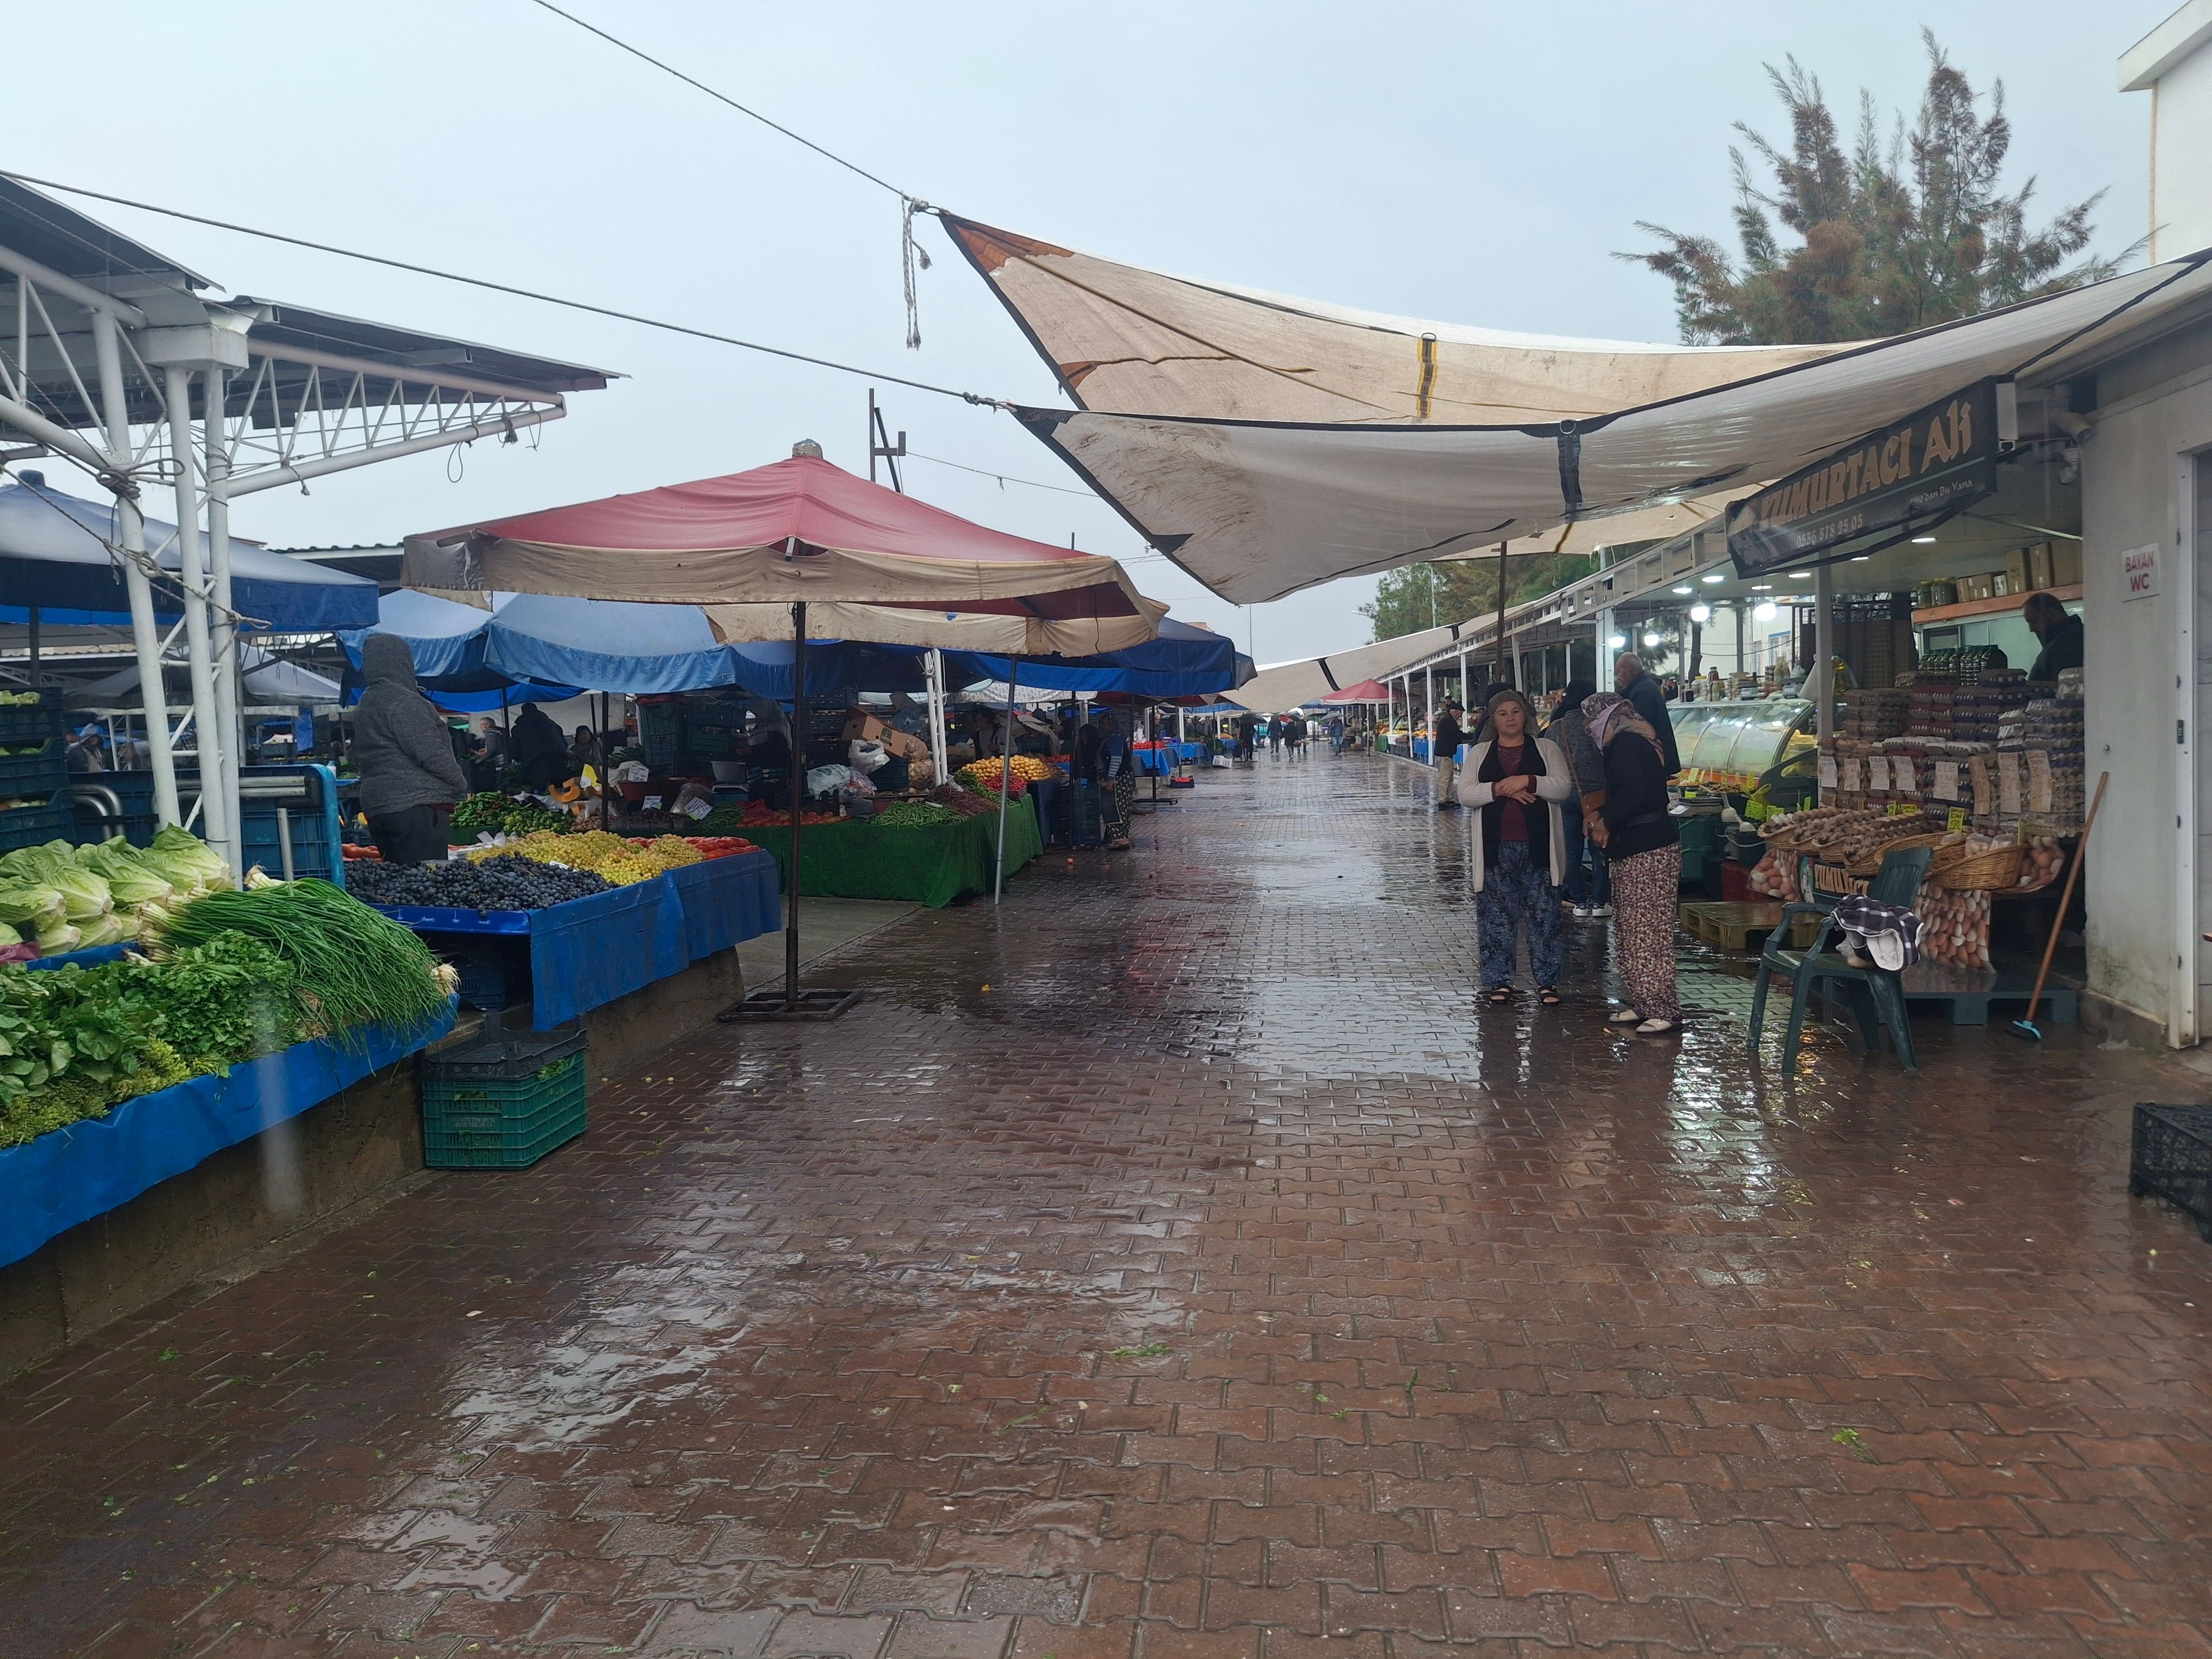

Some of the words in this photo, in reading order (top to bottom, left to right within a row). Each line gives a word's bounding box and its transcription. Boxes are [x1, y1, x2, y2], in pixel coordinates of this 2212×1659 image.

[1819, 523, 1835, 541] 878
[1851, 513, 1863, 530] 05
[2125, 551, 2155, 573] BAYAN
[2130, 573, 2150, 592] WC
